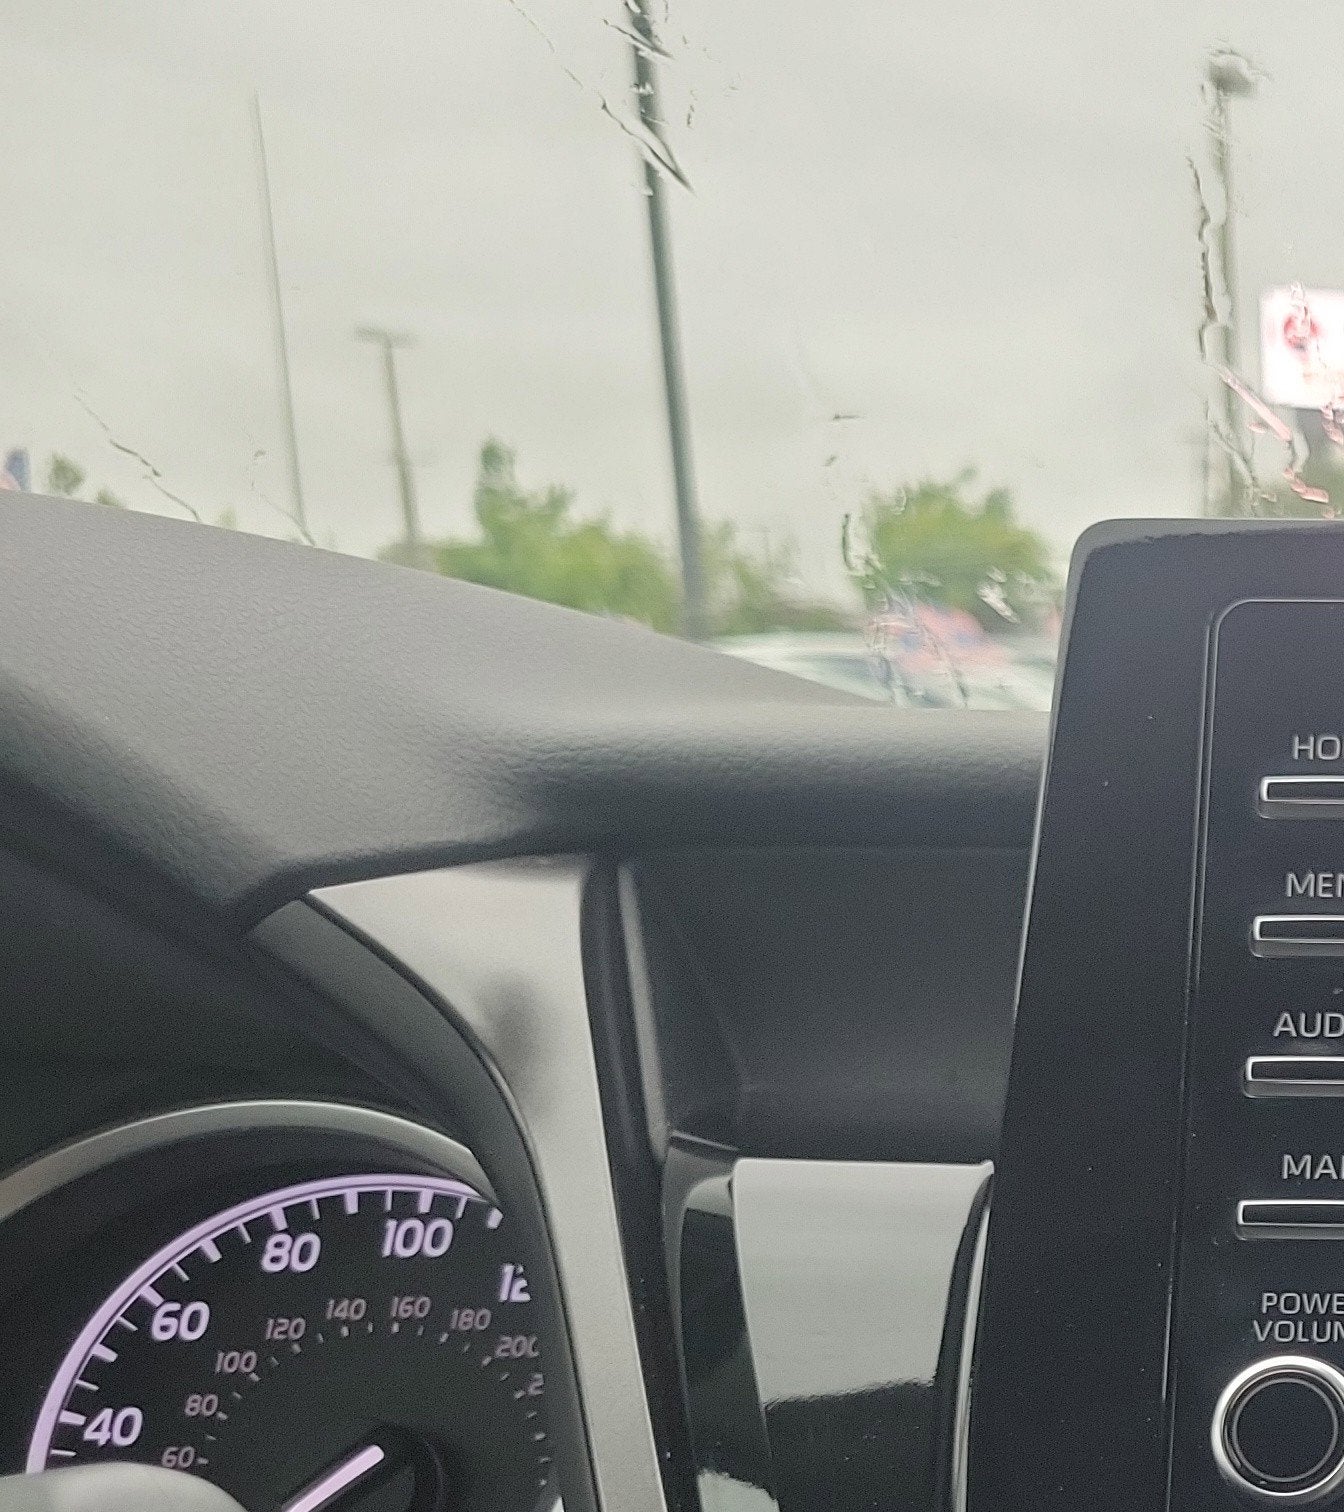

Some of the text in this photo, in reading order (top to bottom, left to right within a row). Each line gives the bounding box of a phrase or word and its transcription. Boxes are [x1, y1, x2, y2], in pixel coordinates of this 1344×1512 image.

[380, 1218, 453, 1258] 100
[260, 1232, 321, 1273] 80
[499, 1263, 532, 1303] 12
[325, 1297, 366, 1321] 140
[388, 1295, 431, 1319] 160
[449, 1306, 492, 1332] 180
[150, 1301, 210, 1342] 60
[264, 1317, 306, 1341] 120
[214, 1349, 257, 1374] 100
[185, 1393, 218, 1417] 80
[83, 1407, 143, 1447] 40
[161, 1445, 196, 1469] 60
